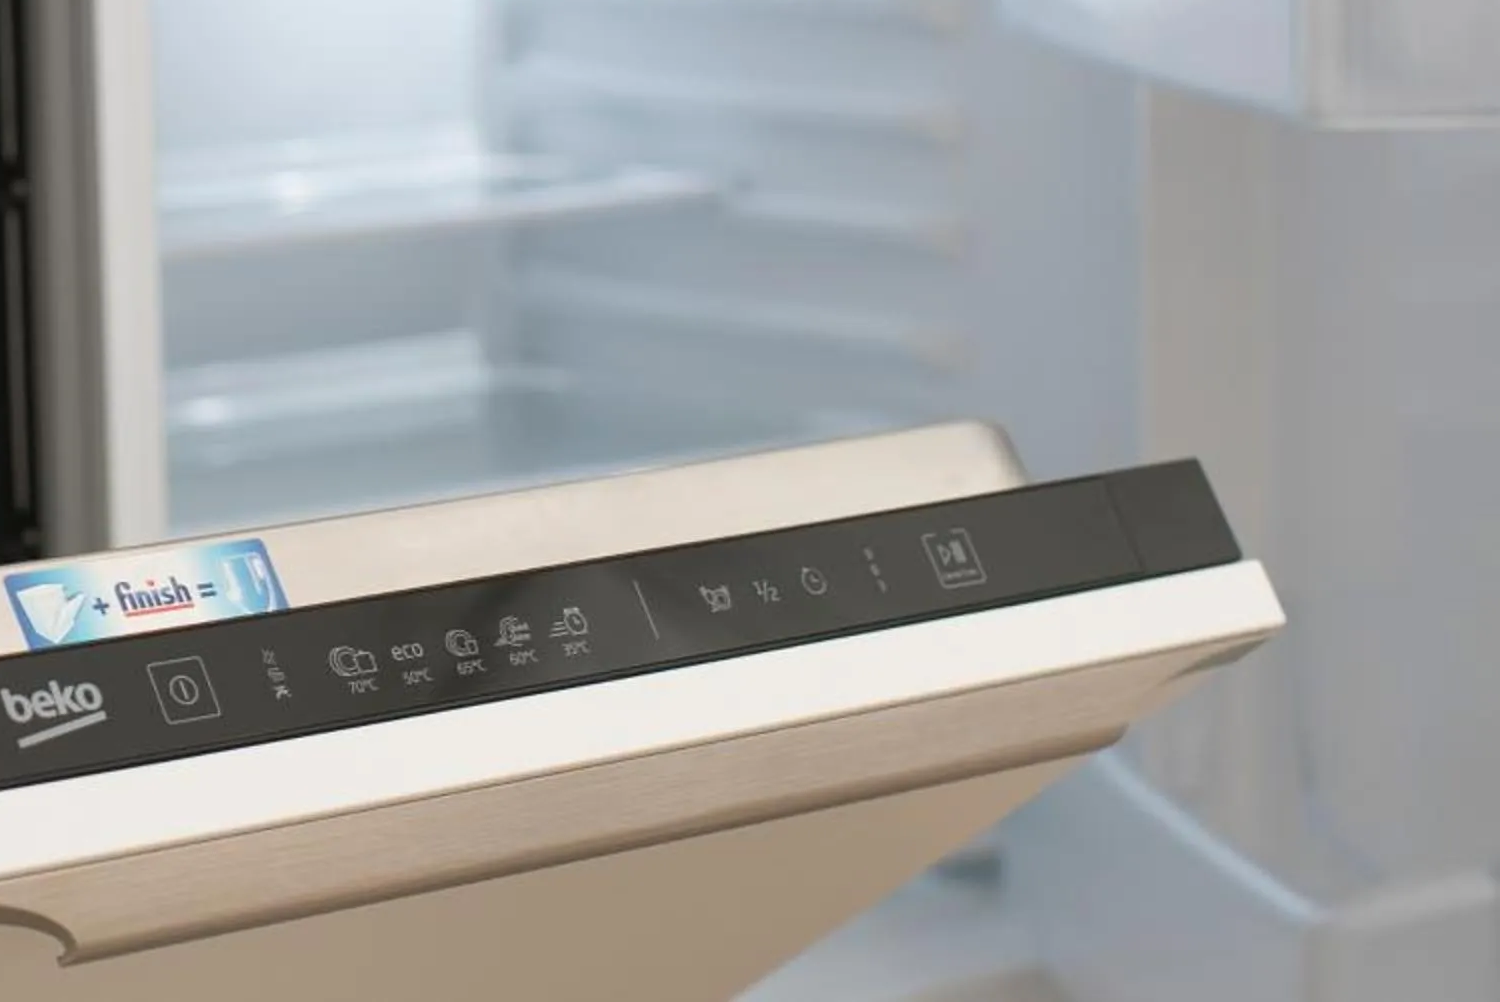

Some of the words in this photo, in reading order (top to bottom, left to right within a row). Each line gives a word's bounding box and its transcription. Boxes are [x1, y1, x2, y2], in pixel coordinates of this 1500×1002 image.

[114, 576, 193, 612] finish
[391, 642, 424, 661] eco
[0, 679, 103, 724] beko
